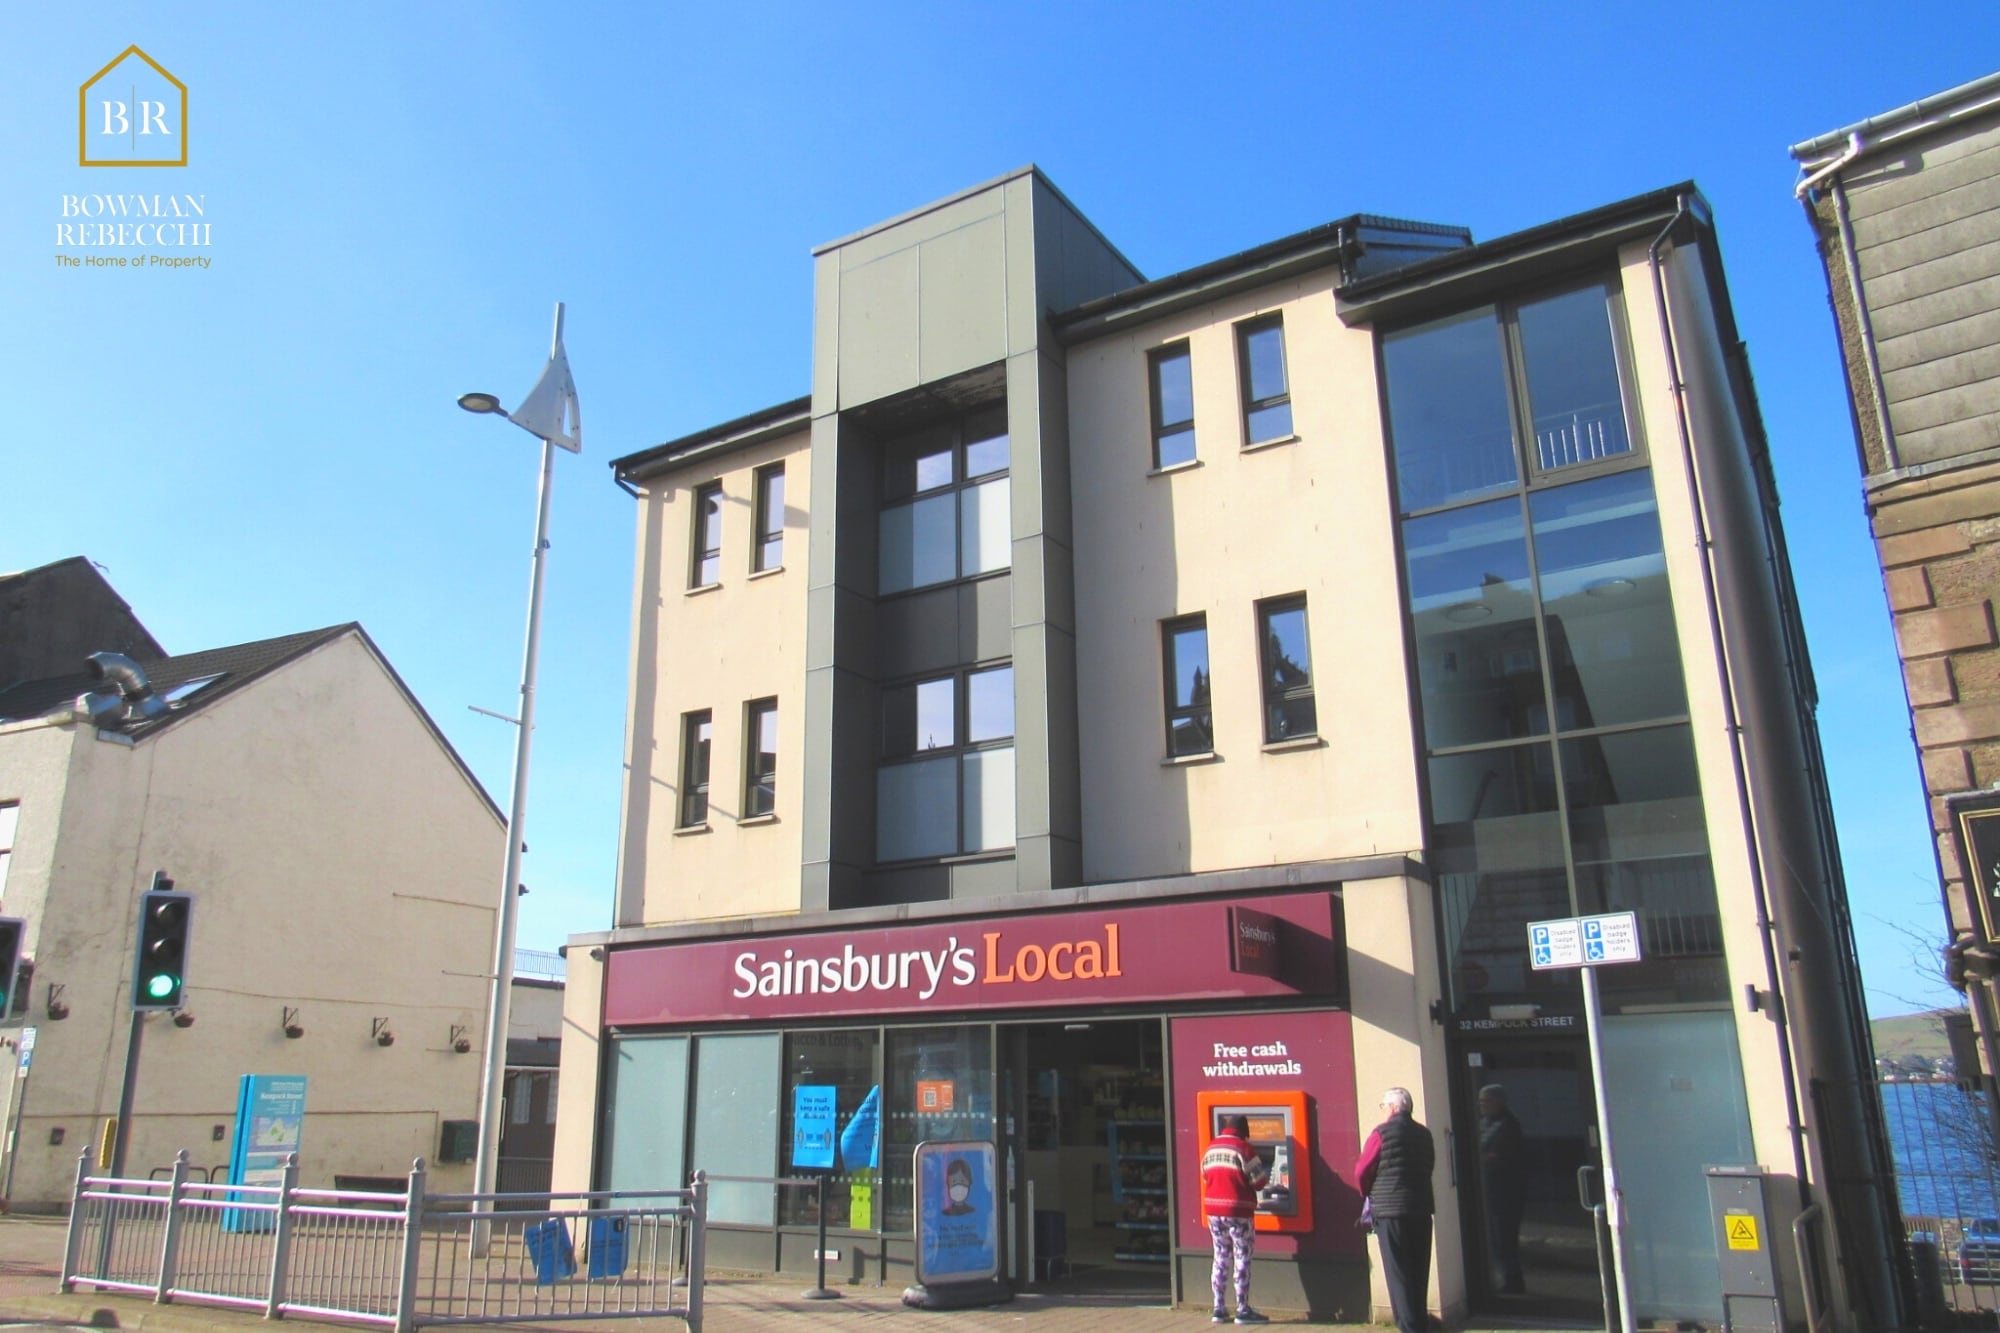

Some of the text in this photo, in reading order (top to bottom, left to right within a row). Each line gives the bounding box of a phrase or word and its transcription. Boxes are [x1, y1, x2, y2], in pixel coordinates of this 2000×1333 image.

[1239, 920, 1276, 946] Sainsbury's
[732, 922, 1123, 999] Sainsbury's Local
[1460, 1020, 1472, 1030] 32
[1531, 1016, 1574, 1027] STREET
[1213, 1041, 1288, 1058] Free cash
[1202, 1059, 1302, 1077] withdrawals
